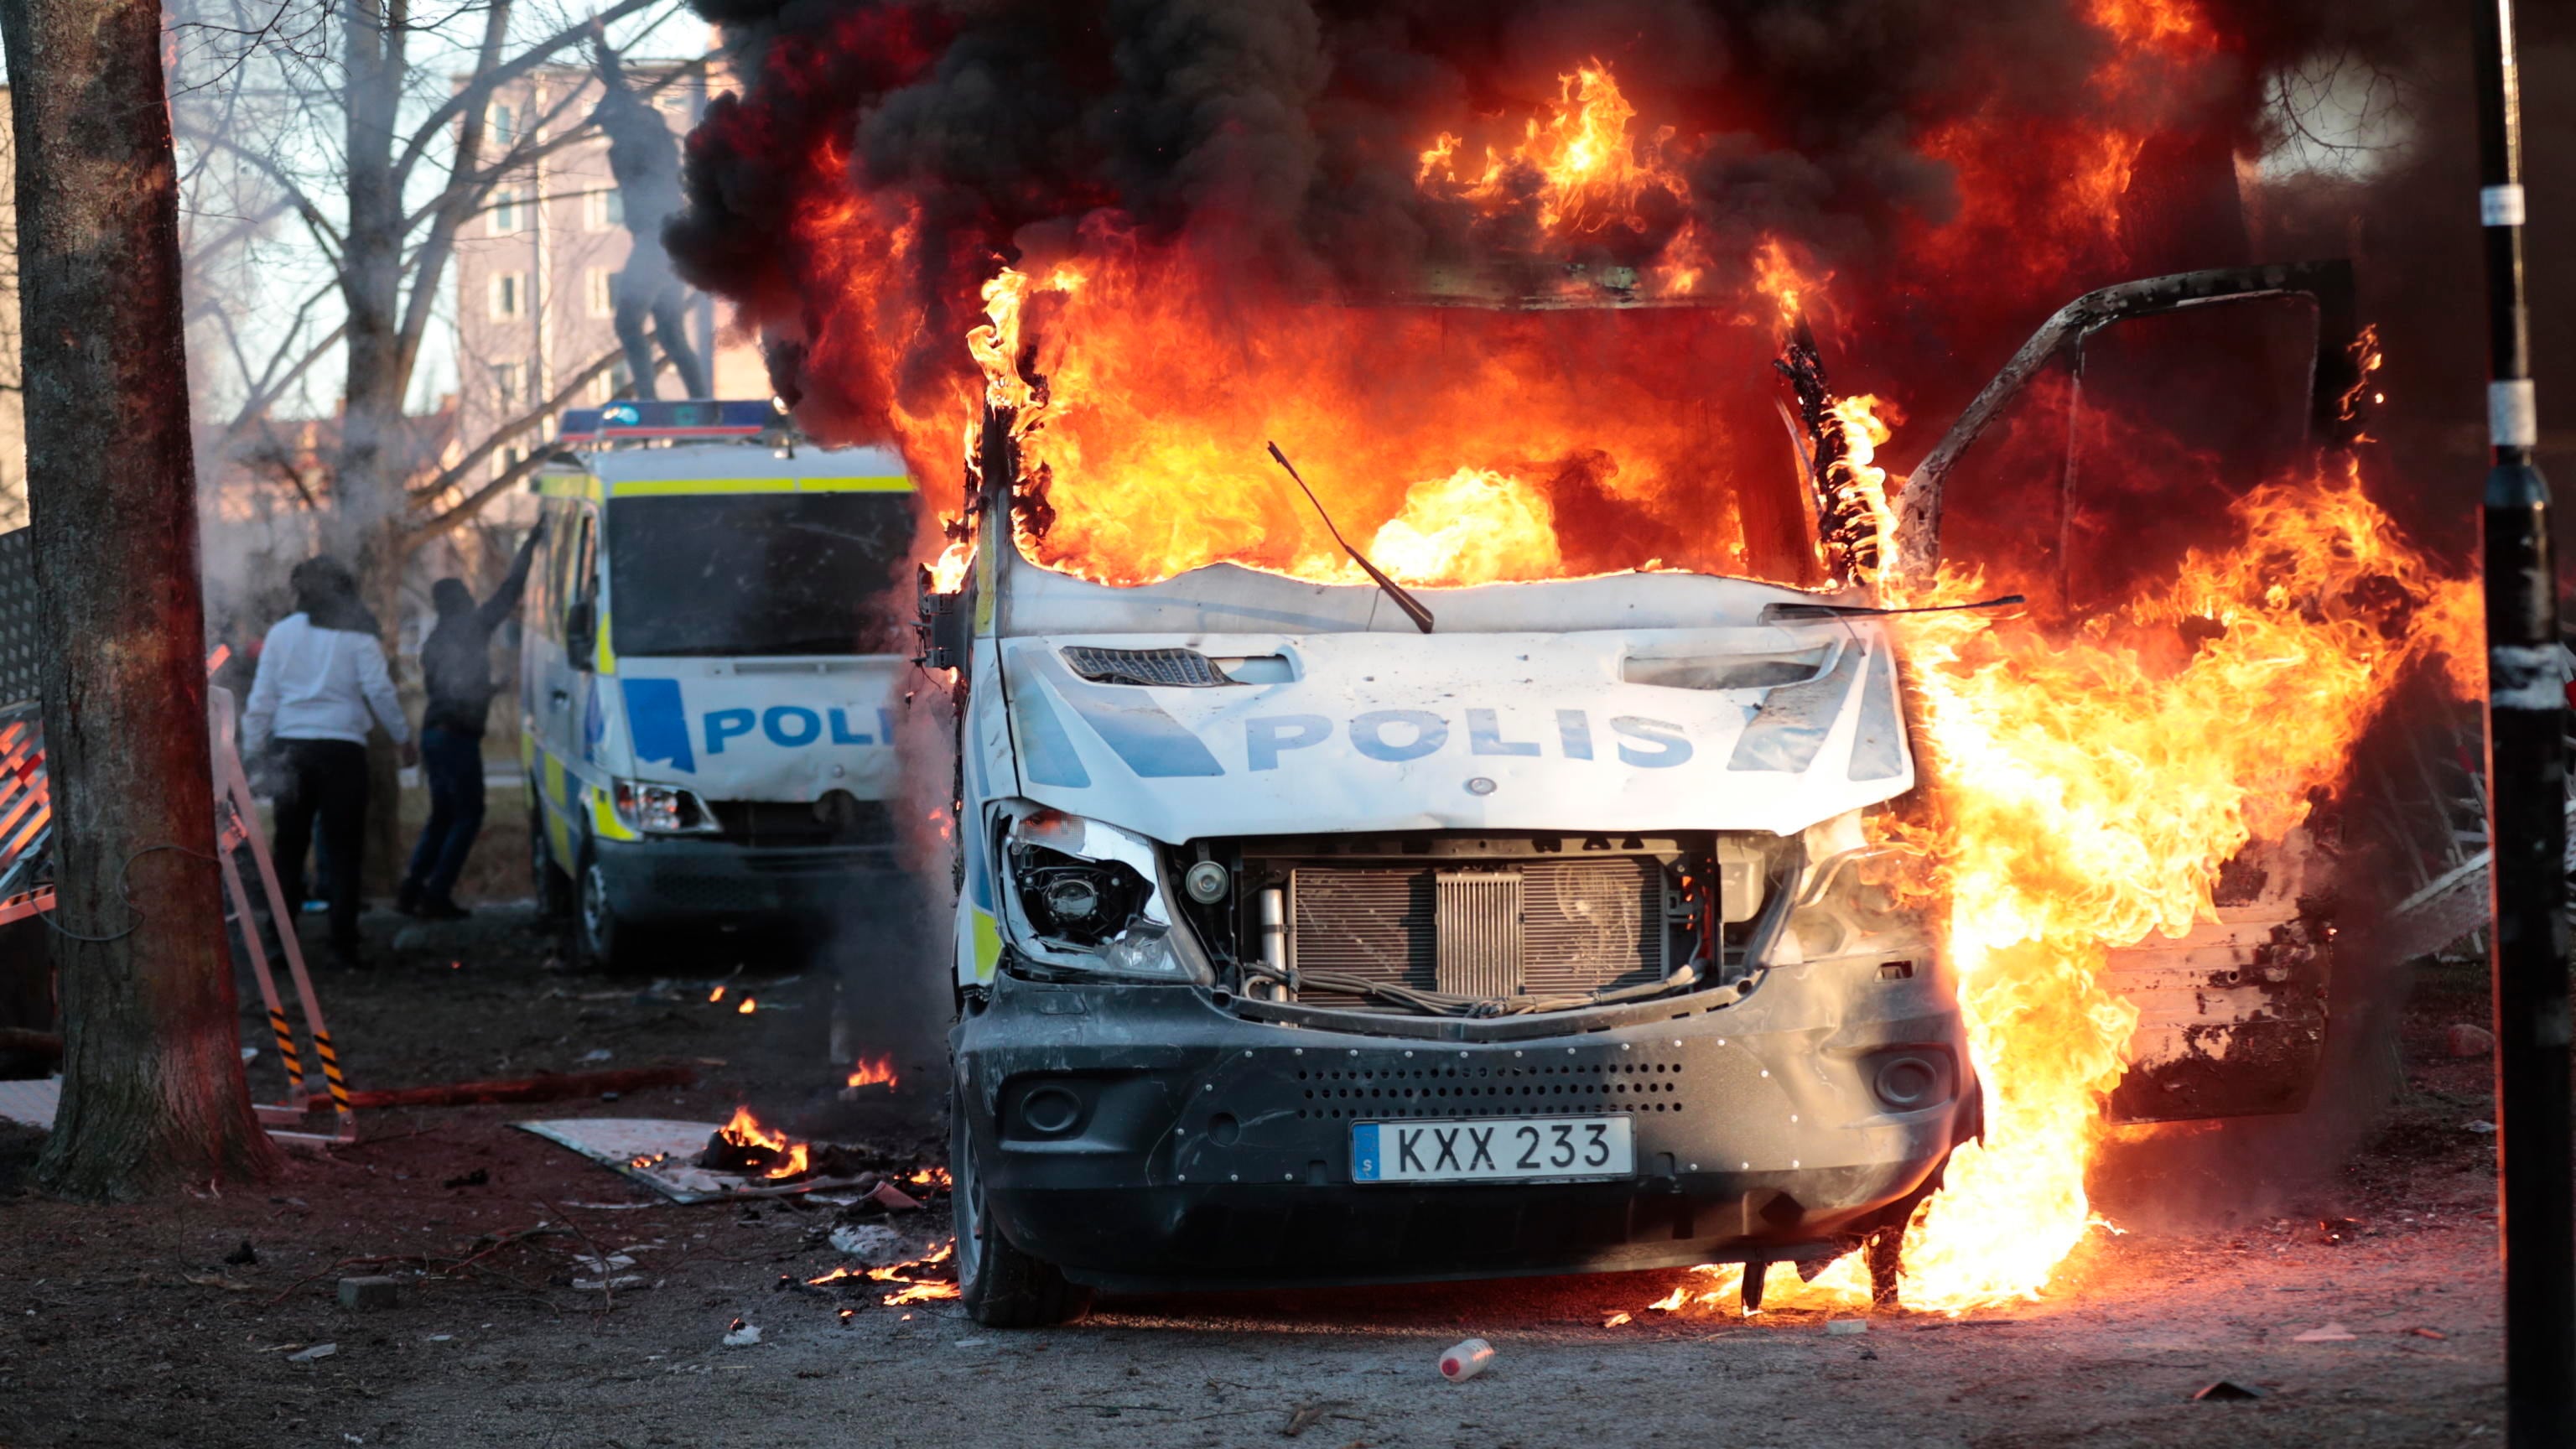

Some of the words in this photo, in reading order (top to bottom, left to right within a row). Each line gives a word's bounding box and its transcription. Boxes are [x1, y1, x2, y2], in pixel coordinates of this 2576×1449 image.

[703, 705, 896, 755] POLI
[1244, 708, 1694, 772] POLIS
[1362, 1159, 1373, 1172] S
[1398, 1127, 1497, 1172] KXX
[1515, 1124, 1610, 1169] 233
